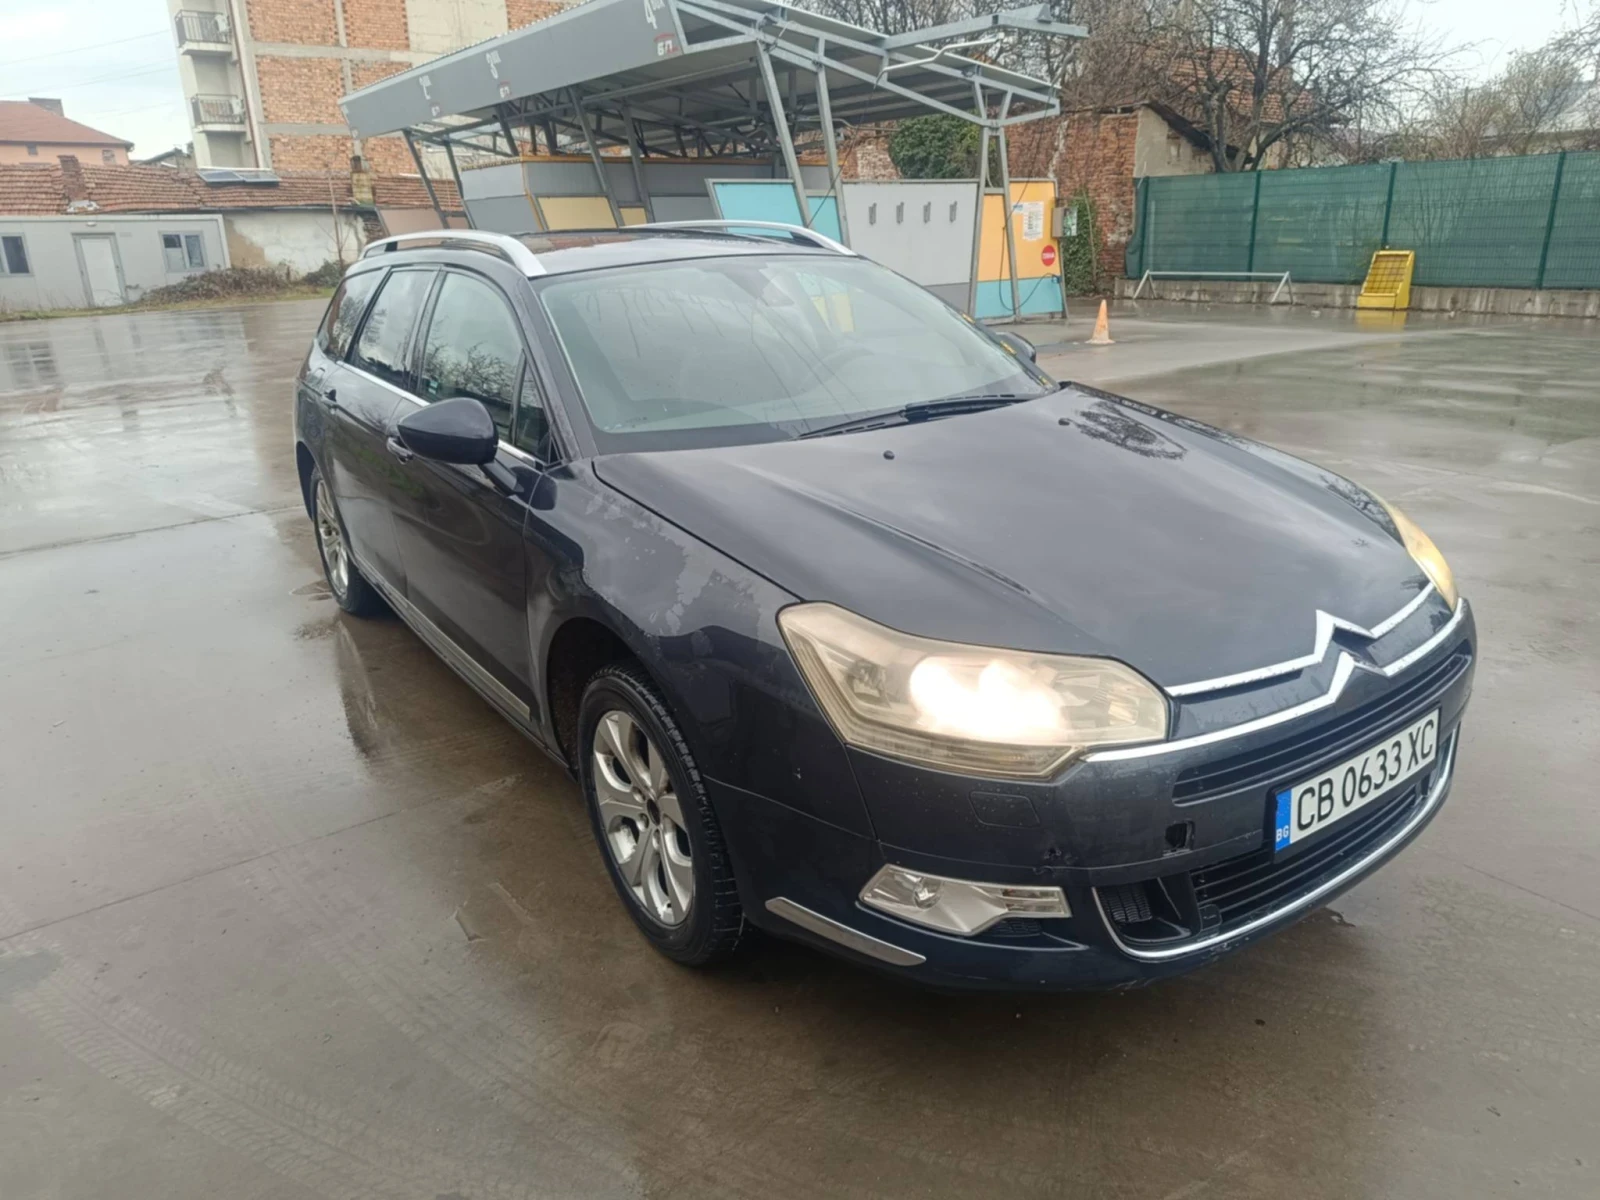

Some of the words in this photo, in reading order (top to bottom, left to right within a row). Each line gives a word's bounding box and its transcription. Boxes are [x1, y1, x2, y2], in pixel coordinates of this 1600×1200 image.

[1297, 777, 1334, 831] CB
[1341, 740, 1402, 808] 0633
[1406, 718, 1434, 772] XC
[1275, 825, 1289, 842] BG
